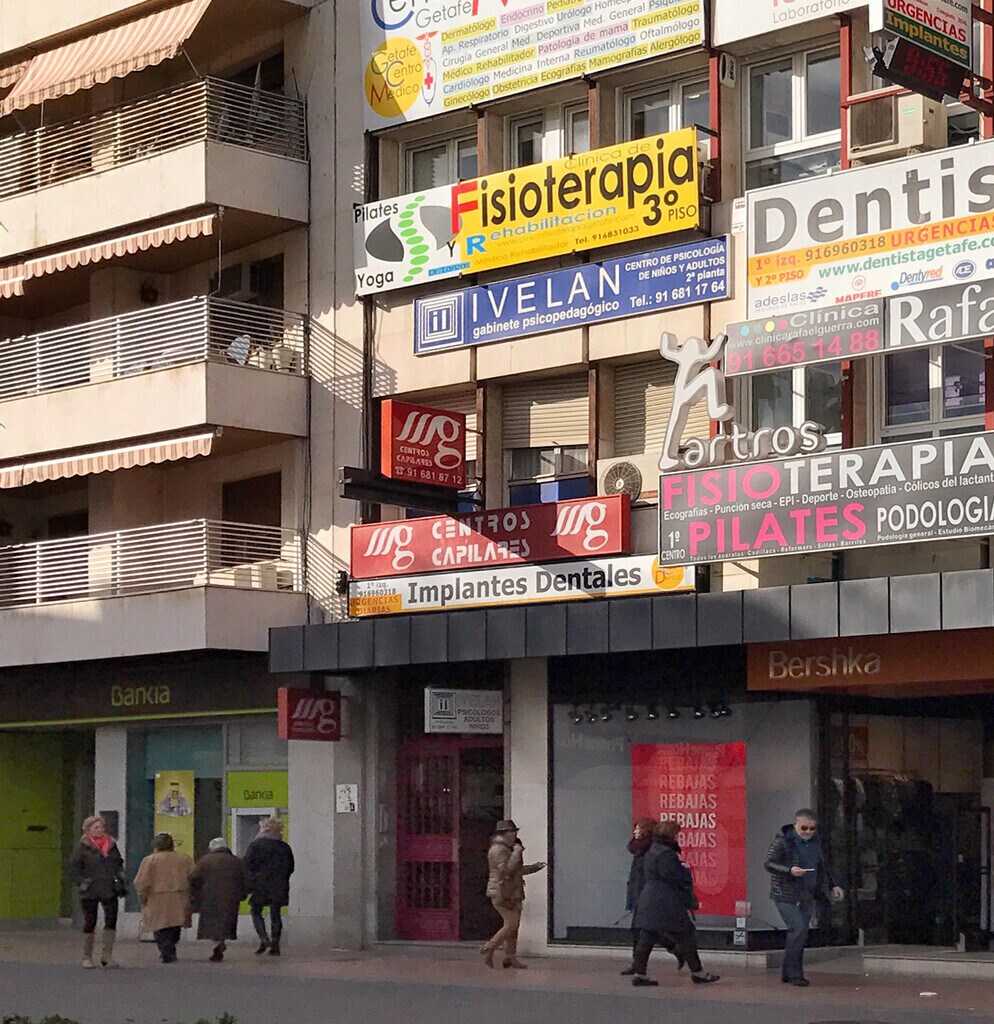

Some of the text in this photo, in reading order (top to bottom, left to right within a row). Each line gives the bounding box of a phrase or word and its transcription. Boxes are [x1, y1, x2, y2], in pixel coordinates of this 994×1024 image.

[415, 1, 472, 29] Getafe
[441, 19, 496, 43] Dermatólogo
[501, 4, 544, 25] Endocrino
[632, 4, 700, 29] Traumatólogo
[651, 32, 701, 51] Alergólogo
[886, 11, 968, 60] Implantes
[451, 138, 695, 235] Fisioterapia
[354, 201, 399, 224] Pilates
[668, 204, 697, 222] PISO
[575, 225, 639, 245] Tel. 916831033
[625, 244, 725, 272] CENTRO DE PSICOLOGÍA
[805, 236, 886, 261] 916960318
[357, 269, 394, 289] Yoga
[638, 256, 725, 281] DE NIÑOS Y ADULTOS
[697, 267, 725, 283] planta
[472, 264, 620, 323] IVELAN
[629, 280, 725, 309] Tel.: 91 681 17 64
[755, 291, 806, 309] adeslas
[472, 298, 619, 340] gabinete psicopedagógico
[790, 303, 879, 326] Clínica
[730, 316, 880, 349] www.clinicarafaelguerra.com
[728, 329, 880, 373] 91 665 14 88
[399, 445, 430, 458] CENTROS
[682, 421, 824, 466] artros
[396, 454, 433, 467] CAPILARES
[407, 468, 462, 484] 91 681 87 12
[715, 500, 750, 515] Punción
[751, 500, 772, 511] seca
[779, 495, 795, 508] EPI
[802, 491, 839, 508] Deporte
[904, 480, 940, 492] Cólicos
[942, 477, 957, 488] del
[431, 511, 531, 539] CENTROS
[689, 502, 866, 556] PILATES
[431, 539, 531, 567] CAPILARES
[661, 548, 686, 561] CENTRO
[407, 565, 642, 607] Implantes Dentales
[768, 649, 881, 679] Bershka
[111, 684, 170, 706] Bankia
[243, 788, 273, 801] Bankia
[660, 775, 716, 790] REBAJAS
[660, 794, 717, 809] REBAJAS
